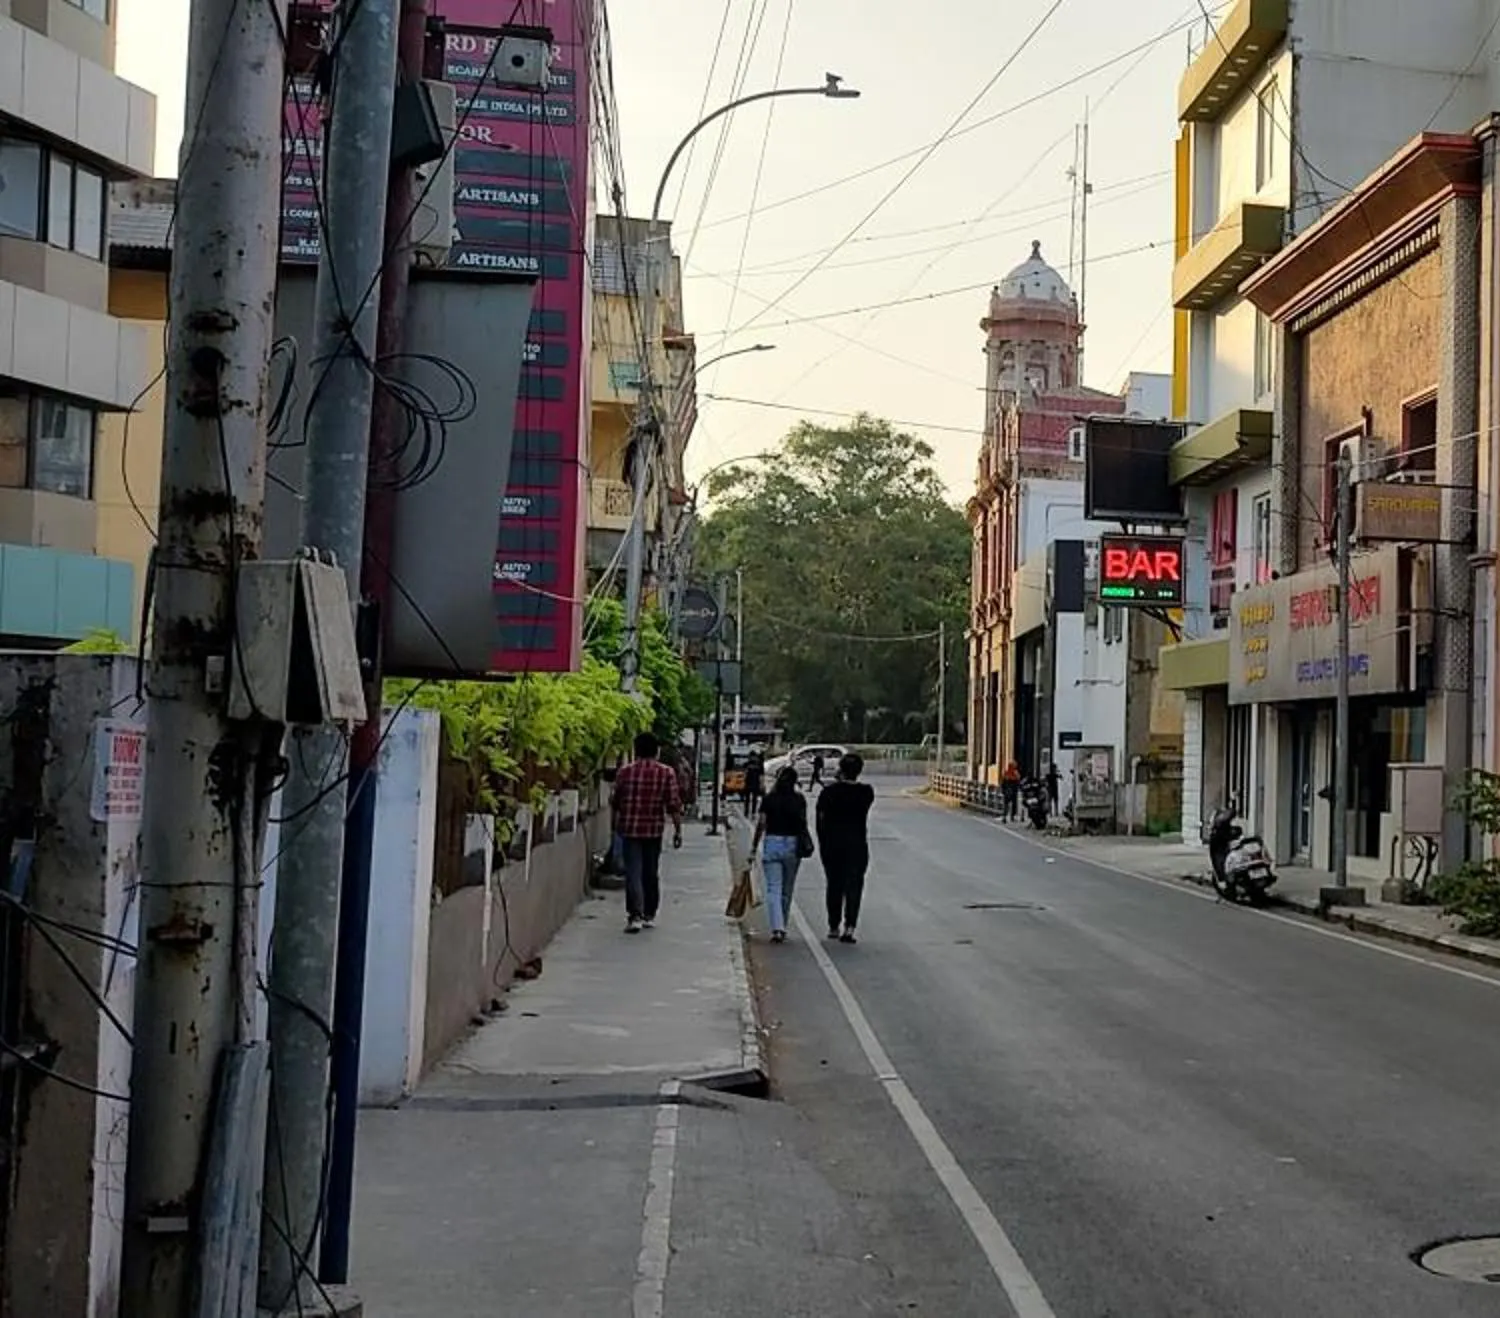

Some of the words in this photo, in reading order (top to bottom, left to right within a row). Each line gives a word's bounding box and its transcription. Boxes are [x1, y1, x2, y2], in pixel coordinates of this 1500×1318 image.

[458, 188, 540, 206] ARTISANS
[457, 252, 539, 270] ARTISANS
[1105, 549, 1179, 580] BAR
